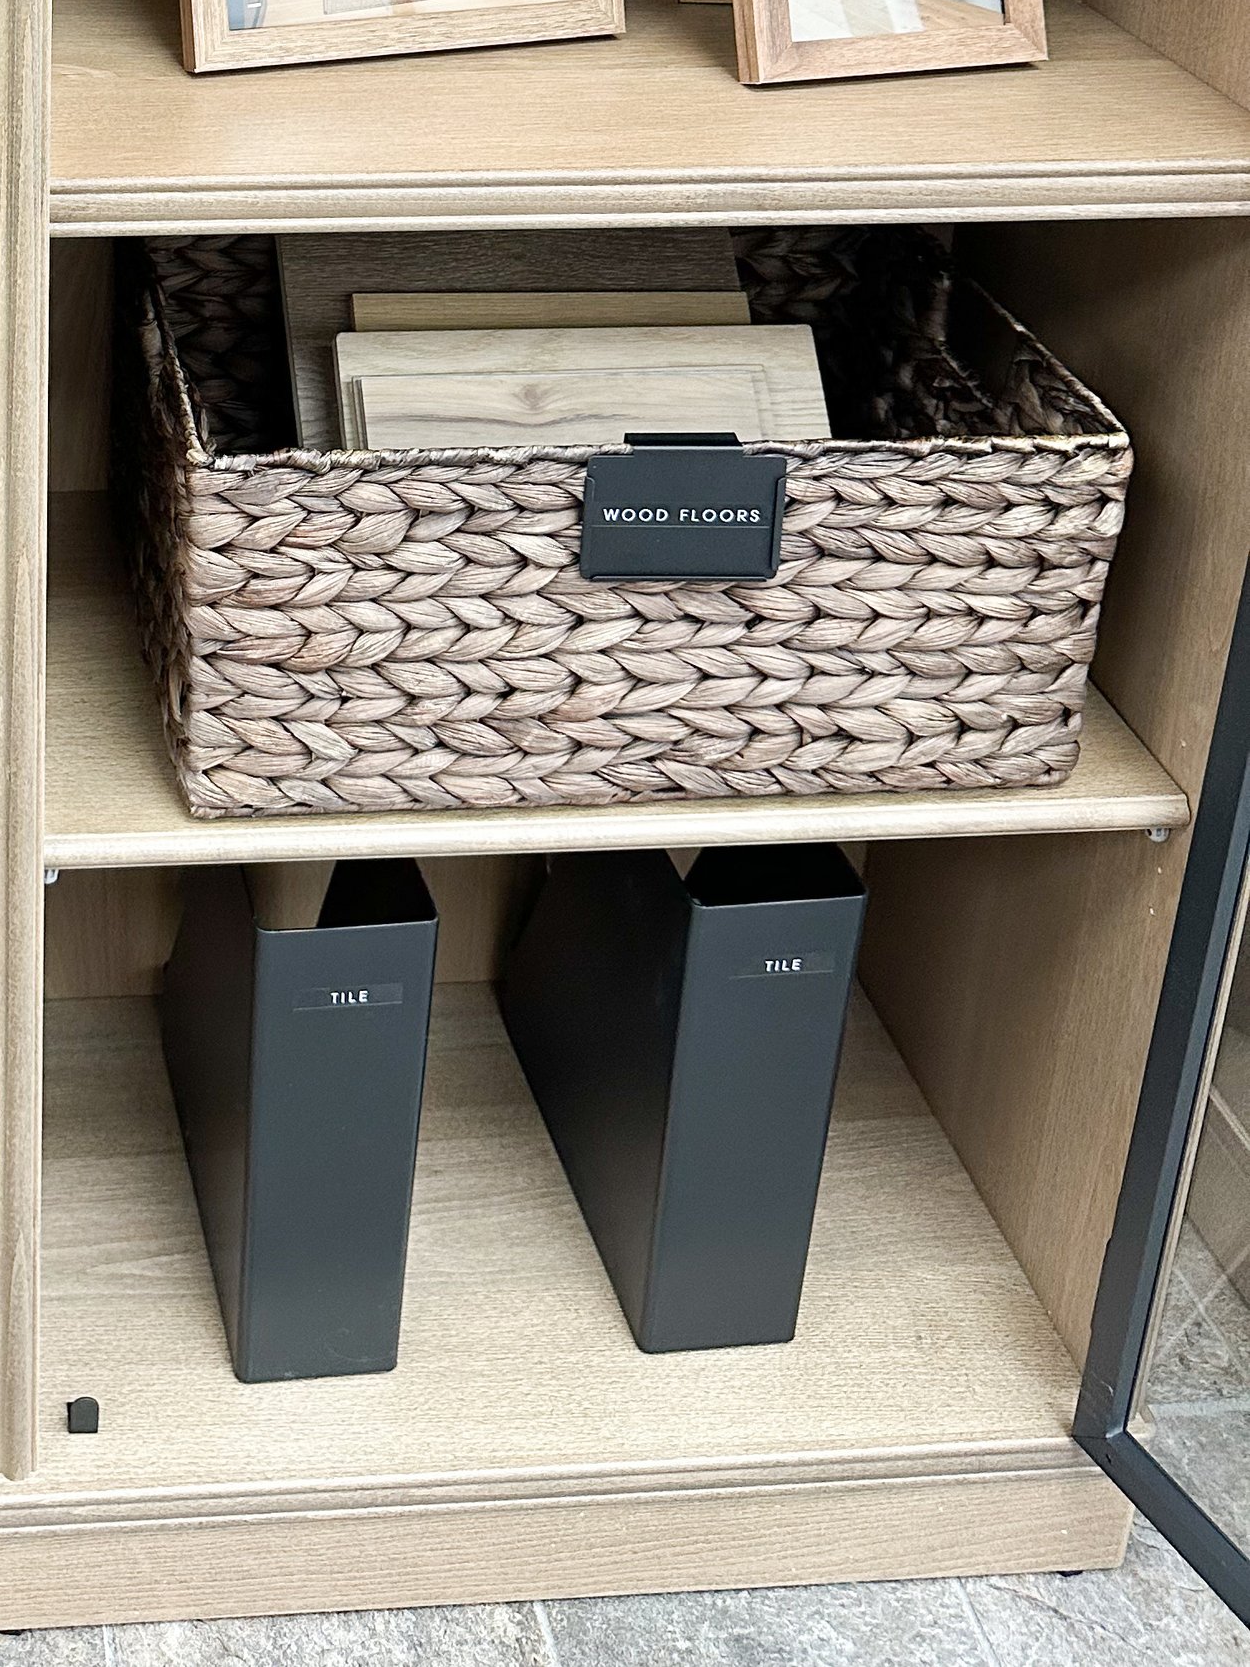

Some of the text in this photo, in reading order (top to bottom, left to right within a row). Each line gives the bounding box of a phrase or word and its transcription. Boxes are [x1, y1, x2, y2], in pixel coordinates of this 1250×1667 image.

[603, 508, 761, 523] WOOD FLOORS
[764, 959, 802, 973] TILE
[330, 990, 369, 1005] TILE
